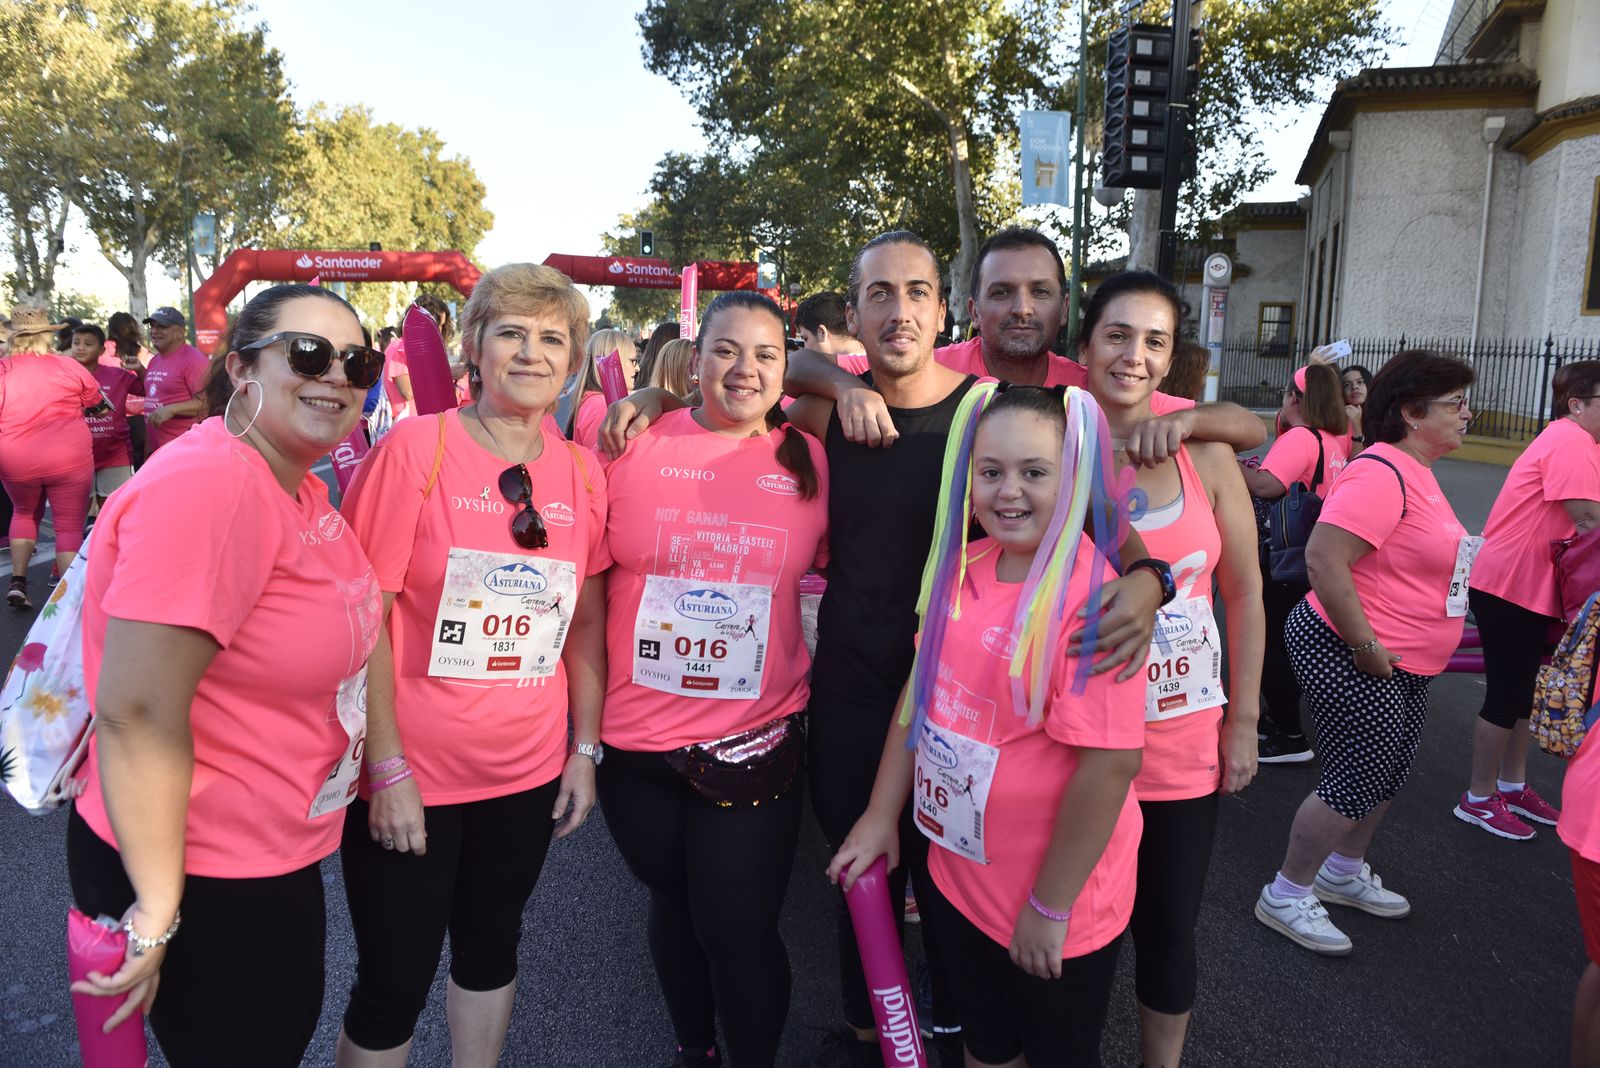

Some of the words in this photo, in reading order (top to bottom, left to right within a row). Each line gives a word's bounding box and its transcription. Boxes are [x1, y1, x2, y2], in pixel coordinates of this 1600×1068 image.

[314, 256, 383, 270] Santander
[661, 466, 715, 481] OYSHO
[655, 507, 680, 522] HOY
[686, 510, 729, 527] GANAN
[695, 530, 730, 543] VITORIA
[739, 535, 774, 549] GASTEIZ
[713, 543, 750, 556] MADRID
[488, 574, 542, 592] ASTURIANA
[678, 599, 733, 615] ASTURIANA
[482, 614, 531, 636] 016
[492, 641, 516, 652] 1831
[674, 636, 728, 660] 016
[438, 656, 475, 668] OYSHO
[685, 662, 712, 673] 1441
[1147, 656, 1190, 683] 016
[640, 668, 671, 682] OYSHO
[1158, 681, 1180, 695] 1439
[917, 765, 949, 809] 016
